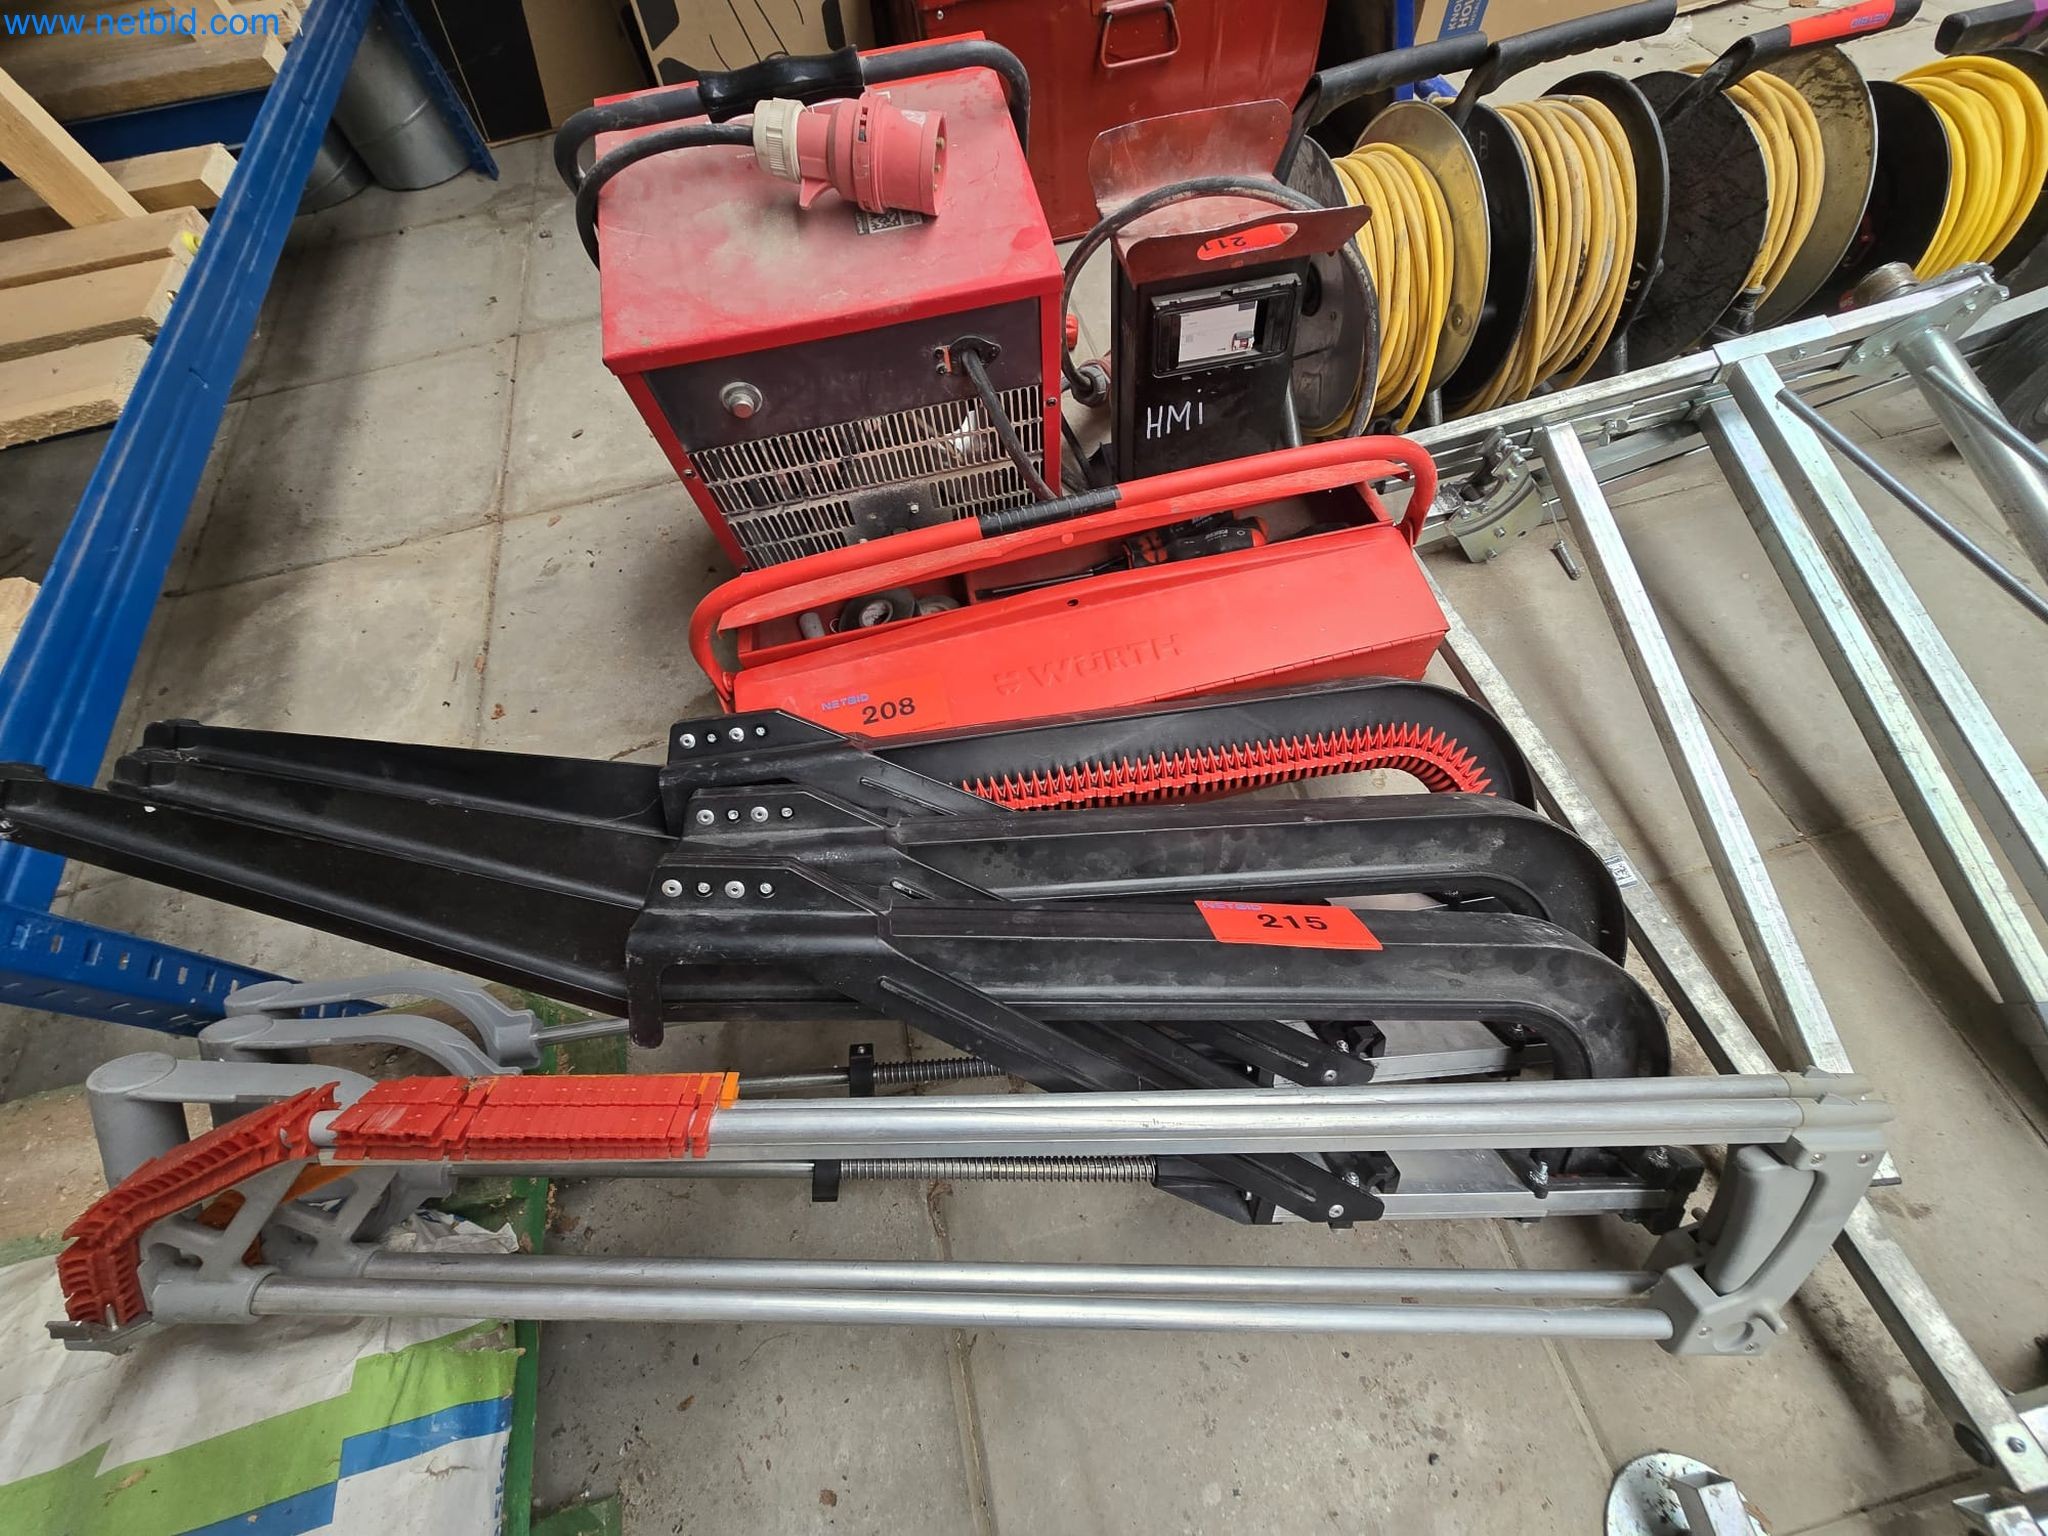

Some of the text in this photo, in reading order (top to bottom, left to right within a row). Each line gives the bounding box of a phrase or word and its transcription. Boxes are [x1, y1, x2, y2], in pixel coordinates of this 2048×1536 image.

[821, 693, 870, 711] NETBID
[862, 697, 915, 725] 208
[1257, 914, 1328, 930] 215
